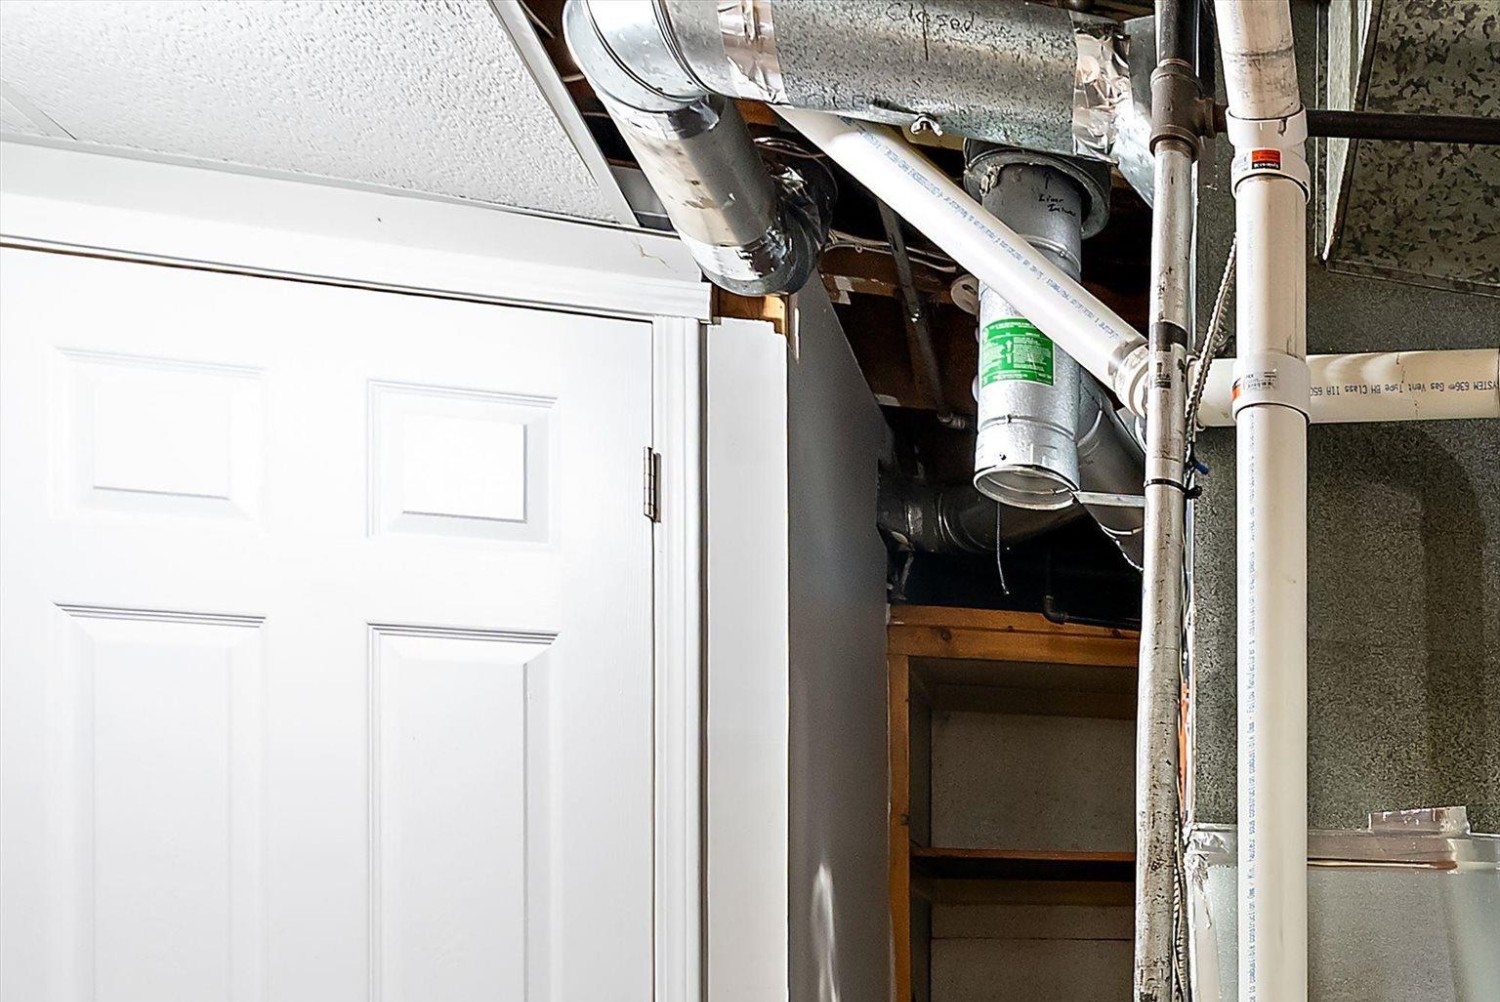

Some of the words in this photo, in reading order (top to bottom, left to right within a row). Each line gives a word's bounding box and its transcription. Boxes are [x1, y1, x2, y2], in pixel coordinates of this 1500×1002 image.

[1344, 384, 1368, 395] Class
[1384, 383, 1404, 394] Type
[1408, 383, 1426, 392] Vent
[1430, 382, 1444, 392] Gas
